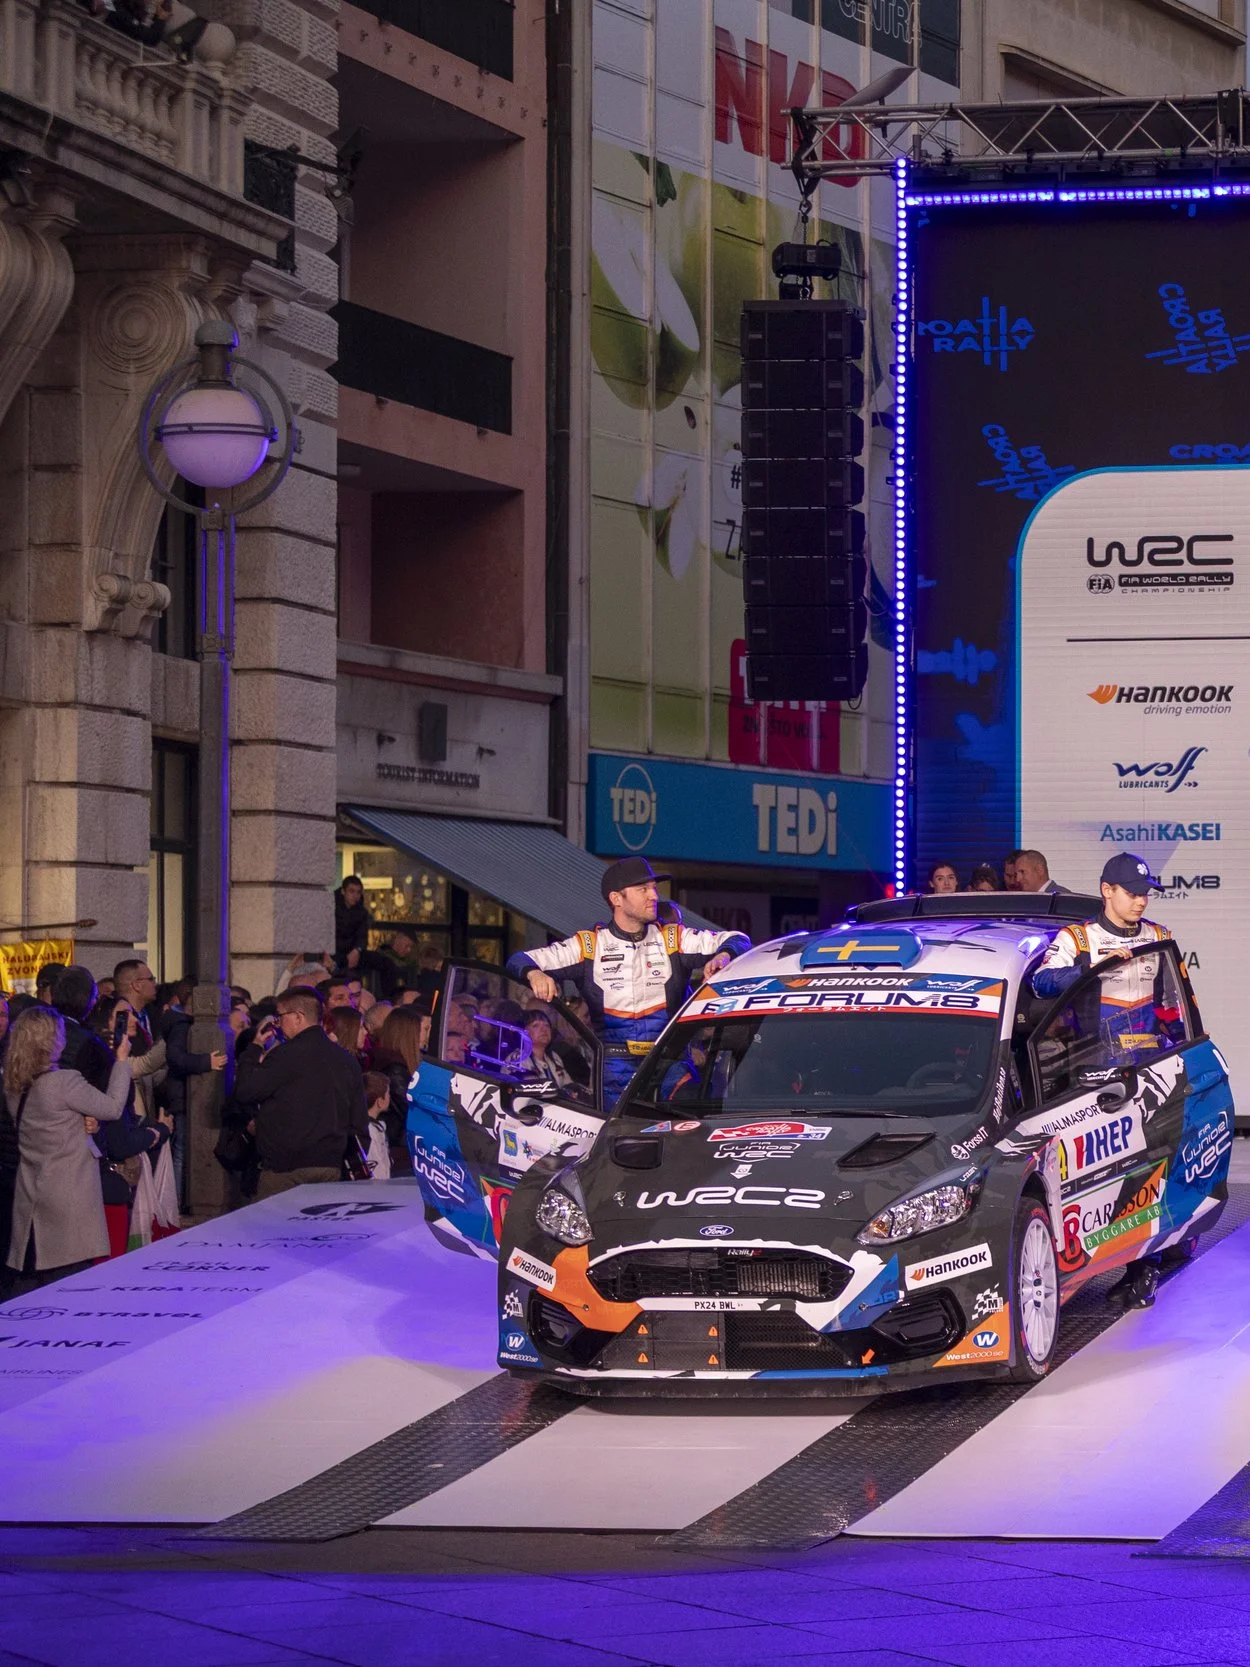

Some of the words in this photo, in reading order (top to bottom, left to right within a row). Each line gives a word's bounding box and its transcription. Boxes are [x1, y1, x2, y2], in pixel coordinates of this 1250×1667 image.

[714, 25, 866, 188] NKD
[1087, 534, 1234, 567] WRC
[1142, 576, 1187, 584] WORLD
[1189, 575, 1231, 583] RALLY
[1116, 685, 1234, 704] HANKOOK
[1144, 705, 1182, 716] driving
[1185, 704, 1232, 714] emotion
[1118, 780, 1169, 789] LUBRICANTS
[610, 786, 657, 825] TEDi
[752, 783, 838, 856] TEDi
[1100, 823, 1221, 842] AsahiKASEI
[1150, 875, 1221, 889] UM8
[808, 977, 915, 988] HANKOOK
[743, 993, 981, 1009] FORUM8
[1095, 1115, 1134, 1161] HEP
[714, 1151, 795, 1159] WRC
[1185, 1131, 1232, 1183] WRC
[414, 1155, 465, 1204] WRC
[636, 1187, 825, 1209] WRC2
[1085, 1212, 1142, 1251] BYGGARE
[1146, 1205, 1161, 1221] AB
[520, 1259, 555, 1285] HANKOOK
[925, 1250, 988, 1279] HANKOOK
[694, 1301, 717, 1310] PX24
[719, 1301, 736, 1310] BWL
[8, 1339, 132, 1348] JANAF
